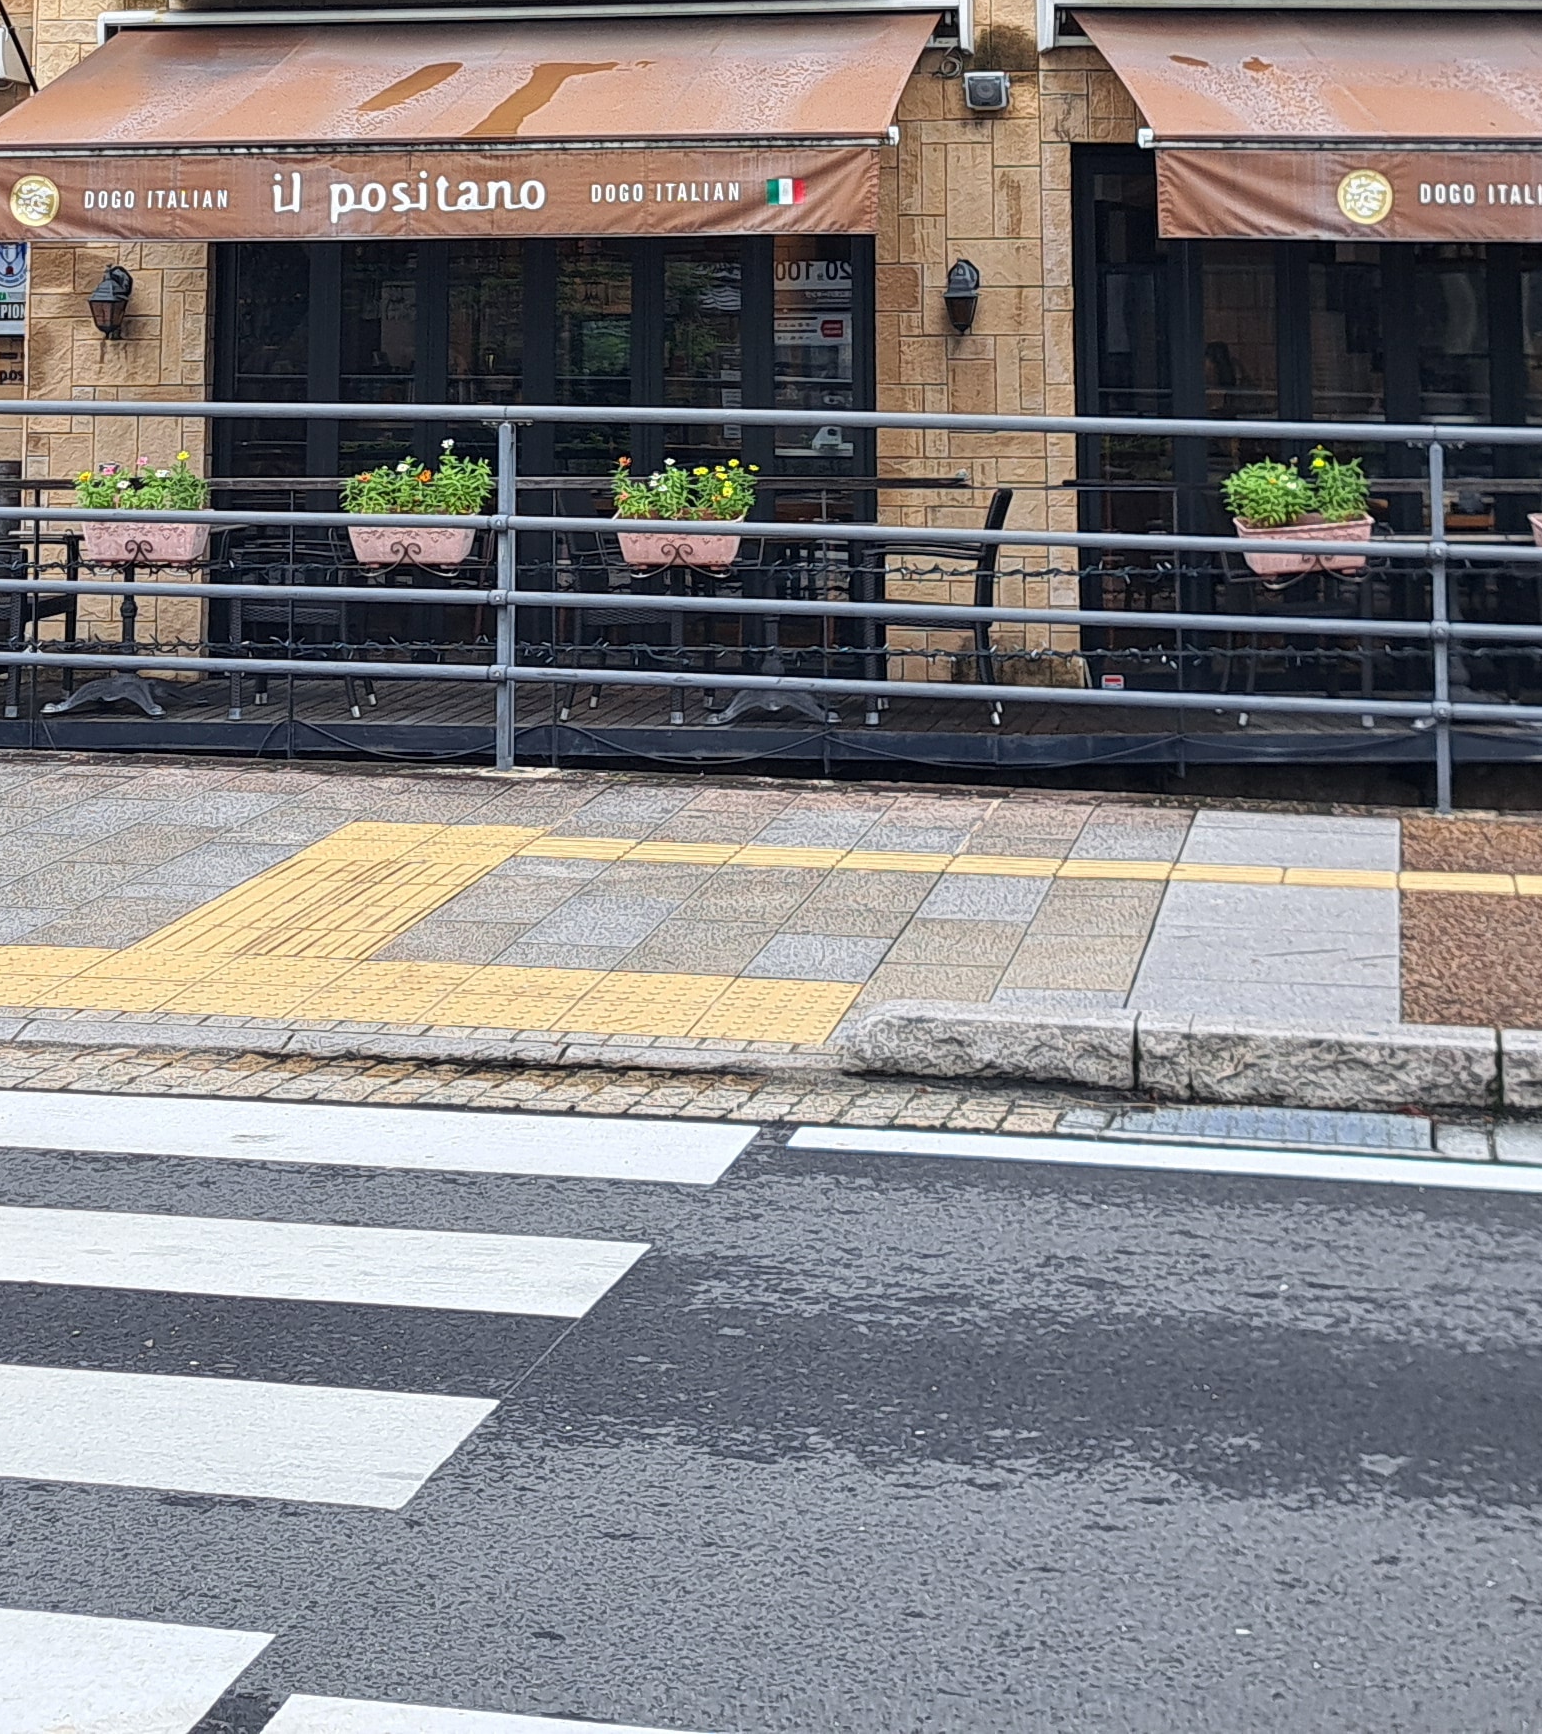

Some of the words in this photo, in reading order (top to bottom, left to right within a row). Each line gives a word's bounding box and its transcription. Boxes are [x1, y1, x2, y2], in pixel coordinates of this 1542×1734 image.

[84, 190, 135, 209] DOGO
[147, 189, 229, 209] ITALIAN
[272, 171, 301, 213] il
[329, 170, 547, 224] positano
[591, 183, 643, 203] DOGO
[656, 182, 740, 203] ITALIAN
[1419, 183, 1476, 205] DOGO
